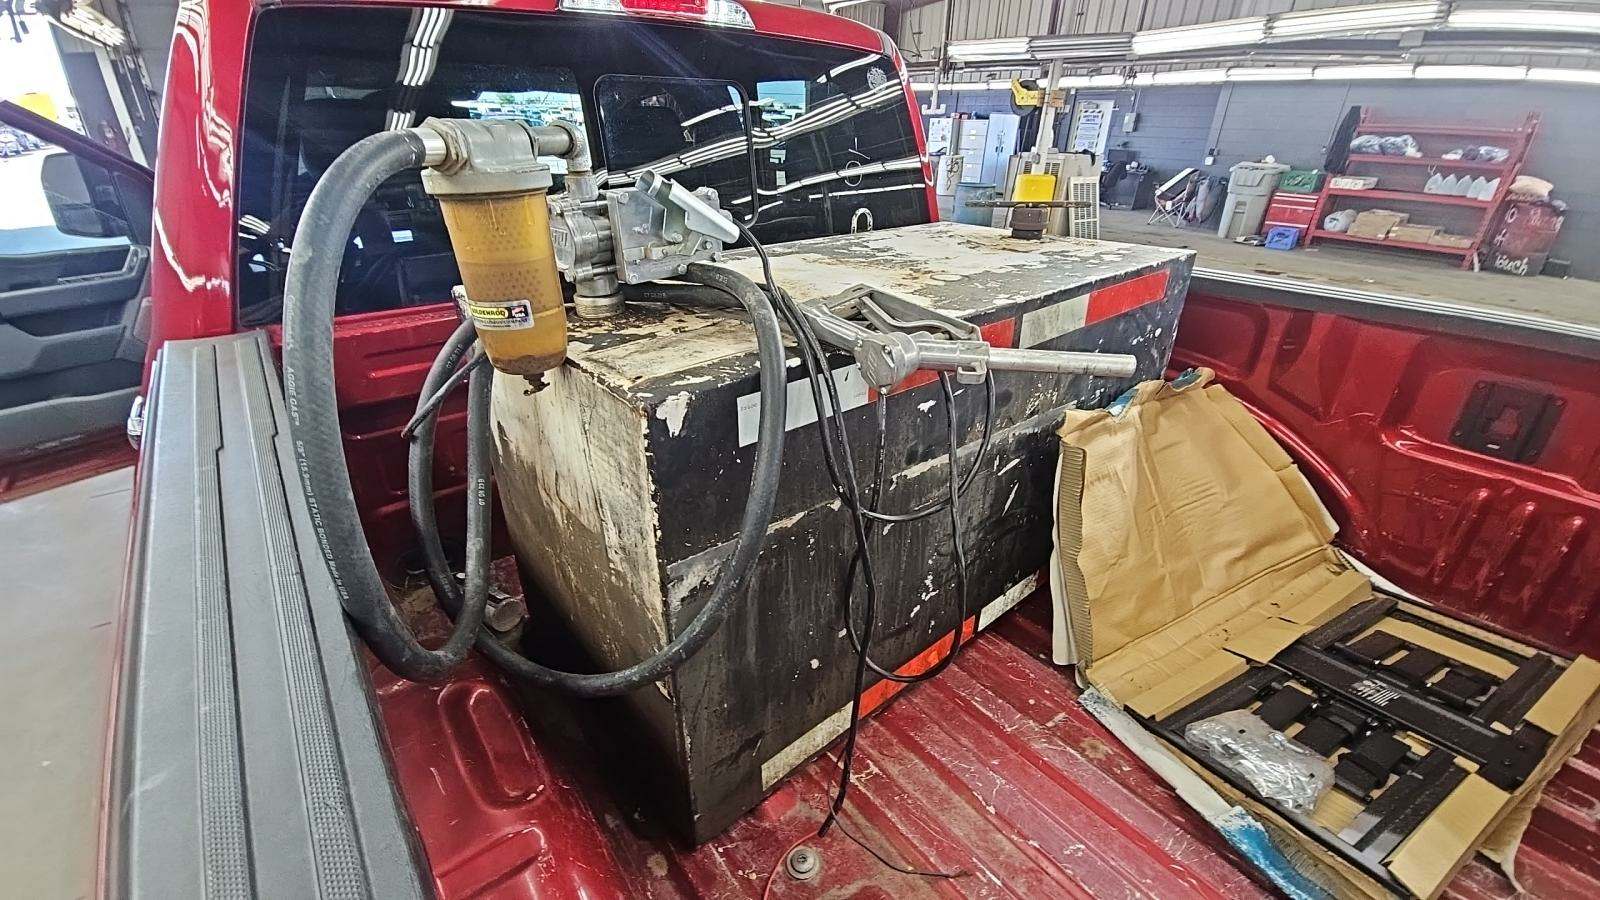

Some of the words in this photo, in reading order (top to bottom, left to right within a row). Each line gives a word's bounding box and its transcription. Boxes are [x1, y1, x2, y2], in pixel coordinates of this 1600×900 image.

[286, 366, 297, 397] AGGIE
[308, 497, 323, 526] STATIC
[316, 527, 333, 559] BONDED
